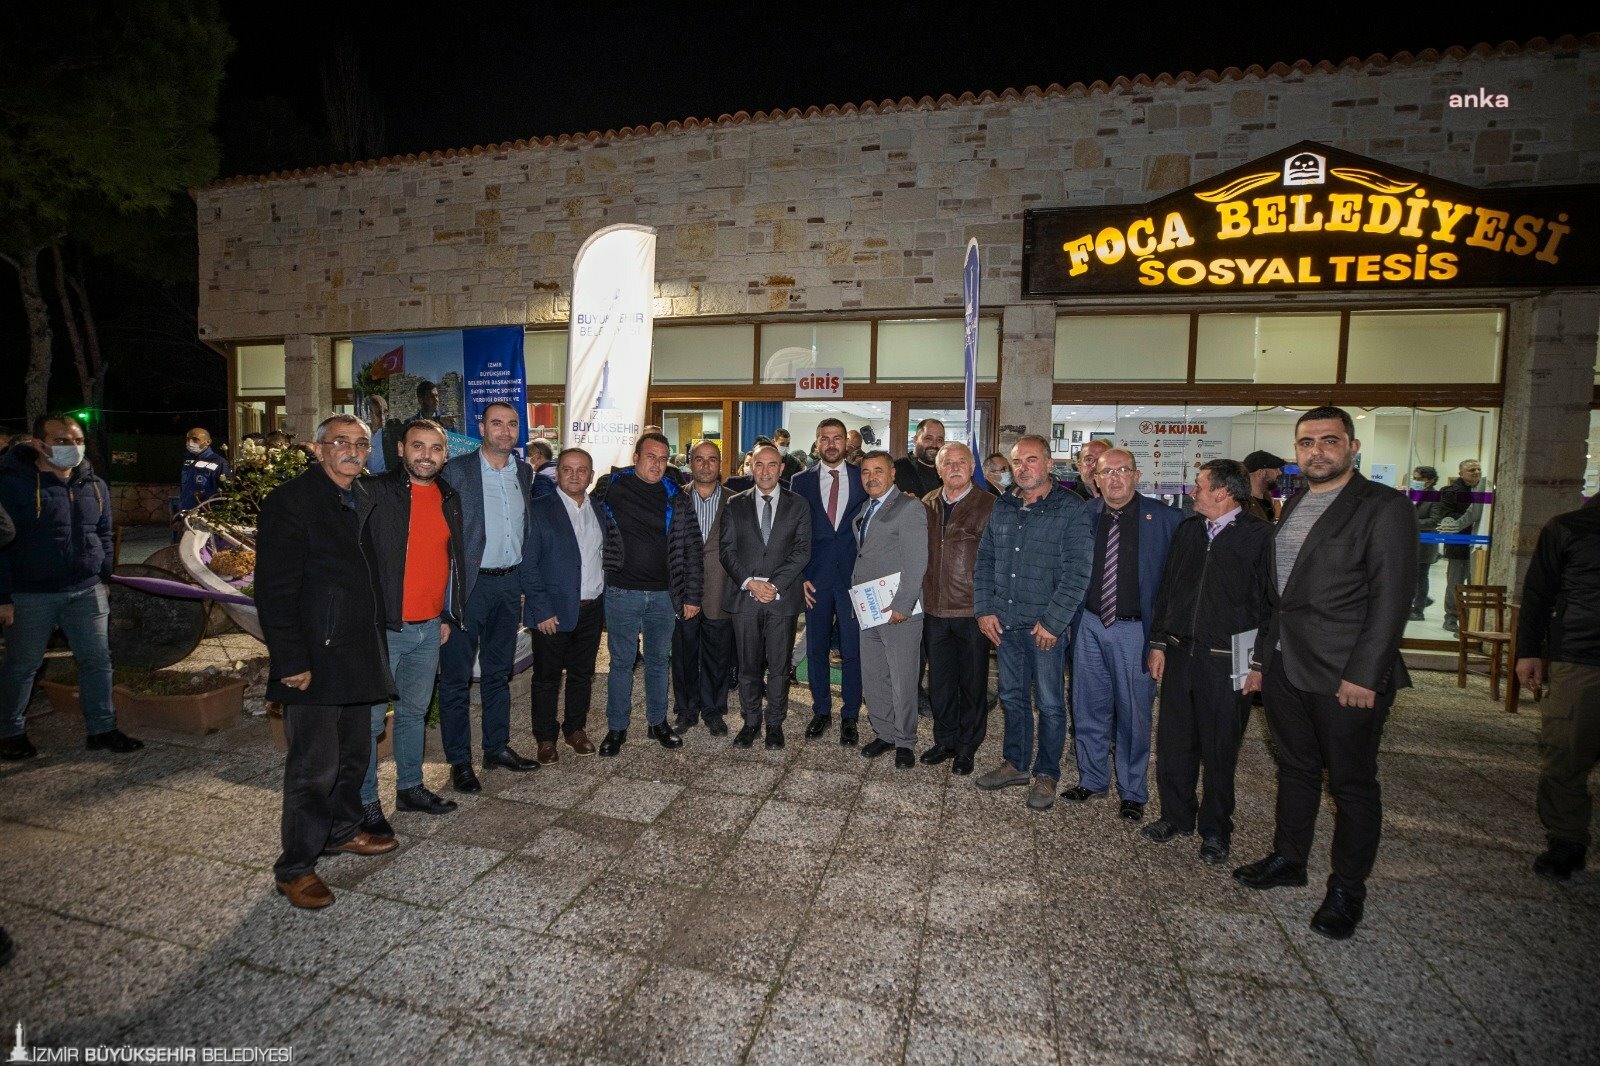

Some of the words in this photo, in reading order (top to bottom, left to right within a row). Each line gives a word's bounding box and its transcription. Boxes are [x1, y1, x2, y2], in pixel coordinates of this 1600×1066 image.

[1063, 212, 1195, 277] FOÇA
[1216, 188, 1571, 265] BELEDİYESİ
[1138, 256, 1321, 286] SOSYAL
[1329, 244, 1458, 282] TESİS
[799, 373, 840, 393] GİRİŞ
[1154, 424, 1167, 435] 14
[1168, 424, 1208, 435] KURAL
